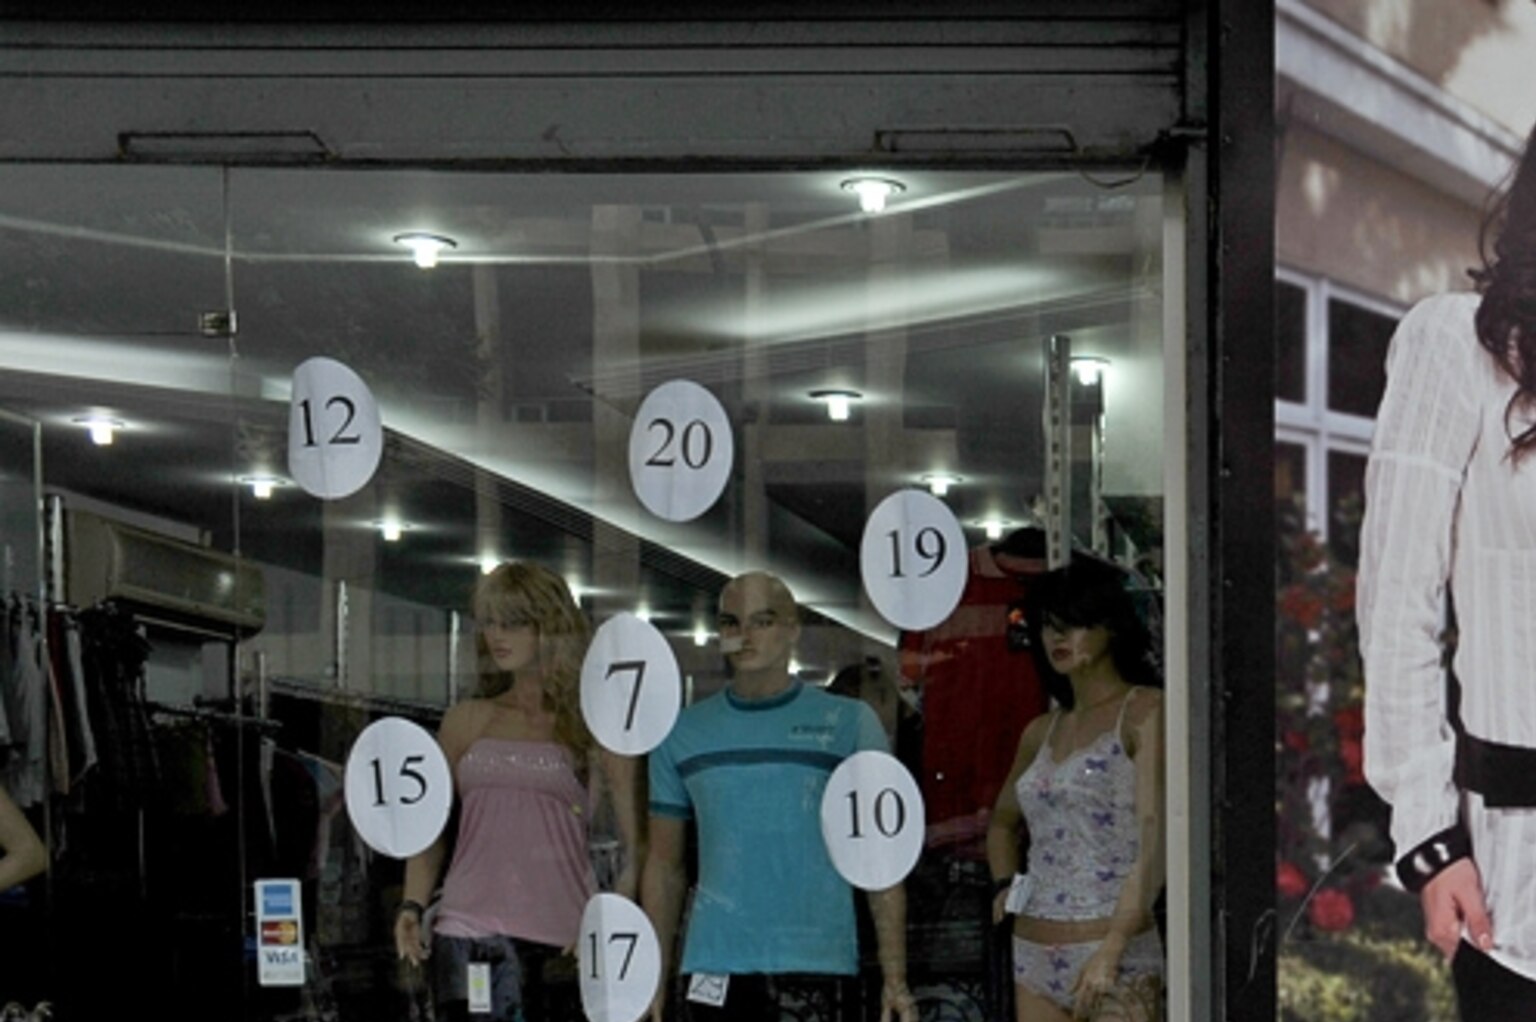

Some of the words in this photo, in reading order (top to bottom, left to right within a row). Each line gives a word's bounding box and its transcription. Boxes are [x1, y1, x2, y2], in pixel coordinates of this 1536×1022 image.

[298, 396, 362, 449] 12
[644, 418, 712, 470] 20
[885, 526, 947, 579] 19
[603, 660, 647, 732] 7
[369, 754, 427, 807] 15
[844, 787, 906, 840] 10
[264, 949, 298, 964] VISA
[588, 932, 639, 981] 17
